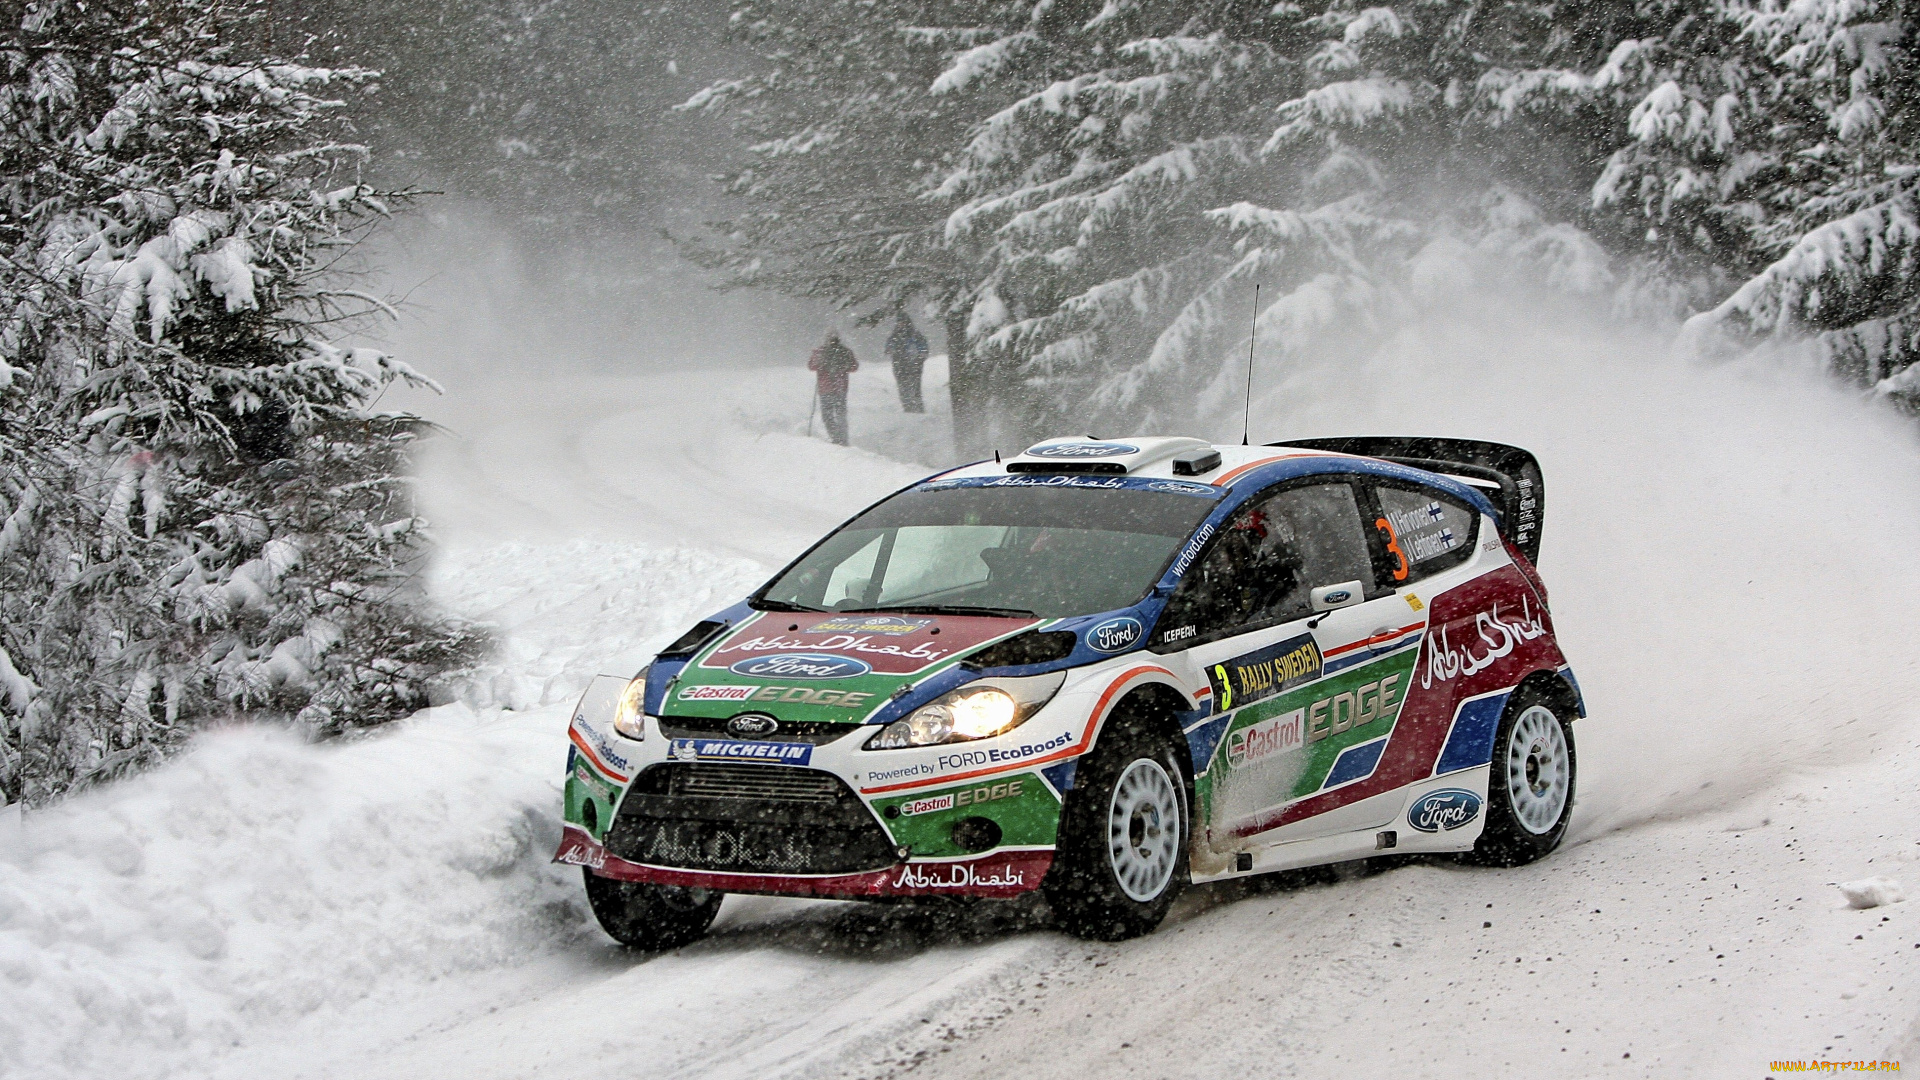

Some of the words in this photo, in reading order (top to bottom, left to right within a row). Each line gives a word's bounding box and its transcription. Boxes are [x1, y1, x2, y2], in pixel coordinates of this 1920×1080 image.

[1040, 443, 1119, 457] Ford
[1172, 523, 1215, 578] wrcford.com
[1375, 518, 1409, 581] 3
[1097, 622, 1134, 649] Ford
[1164, 625, 1196, 643] ICEPEAK
[749, 656, 848, 676] Ford
[1237, 661, 1273, 696] RALLY
[1275, 641, 1320, 684] SWEDEN
[692, 686, 753, 700] Castrol
[753, 686, 876, 708] EDGE
[1215, 664, 1232, 711] 3
[1246, 713, 1300, 760] Castrol
[1308, 673, 1400, 744] EDGE
[701, 743, 806, 759] MICHELIN
[868, 766, 919, 782] Powered
[921, 763, 935, 775] by
[938, 752, 987, 771] FORD
[989, 731, 1073, 763] EcoBoost
[870, 738, 908, 749] PIAA
[914, 797, 952, 814] Castrol
[956, 780, 1025, 807] EDGE
[1419, 796, 1468, 828] Ford
[873, 873, 888, 888] TOW
